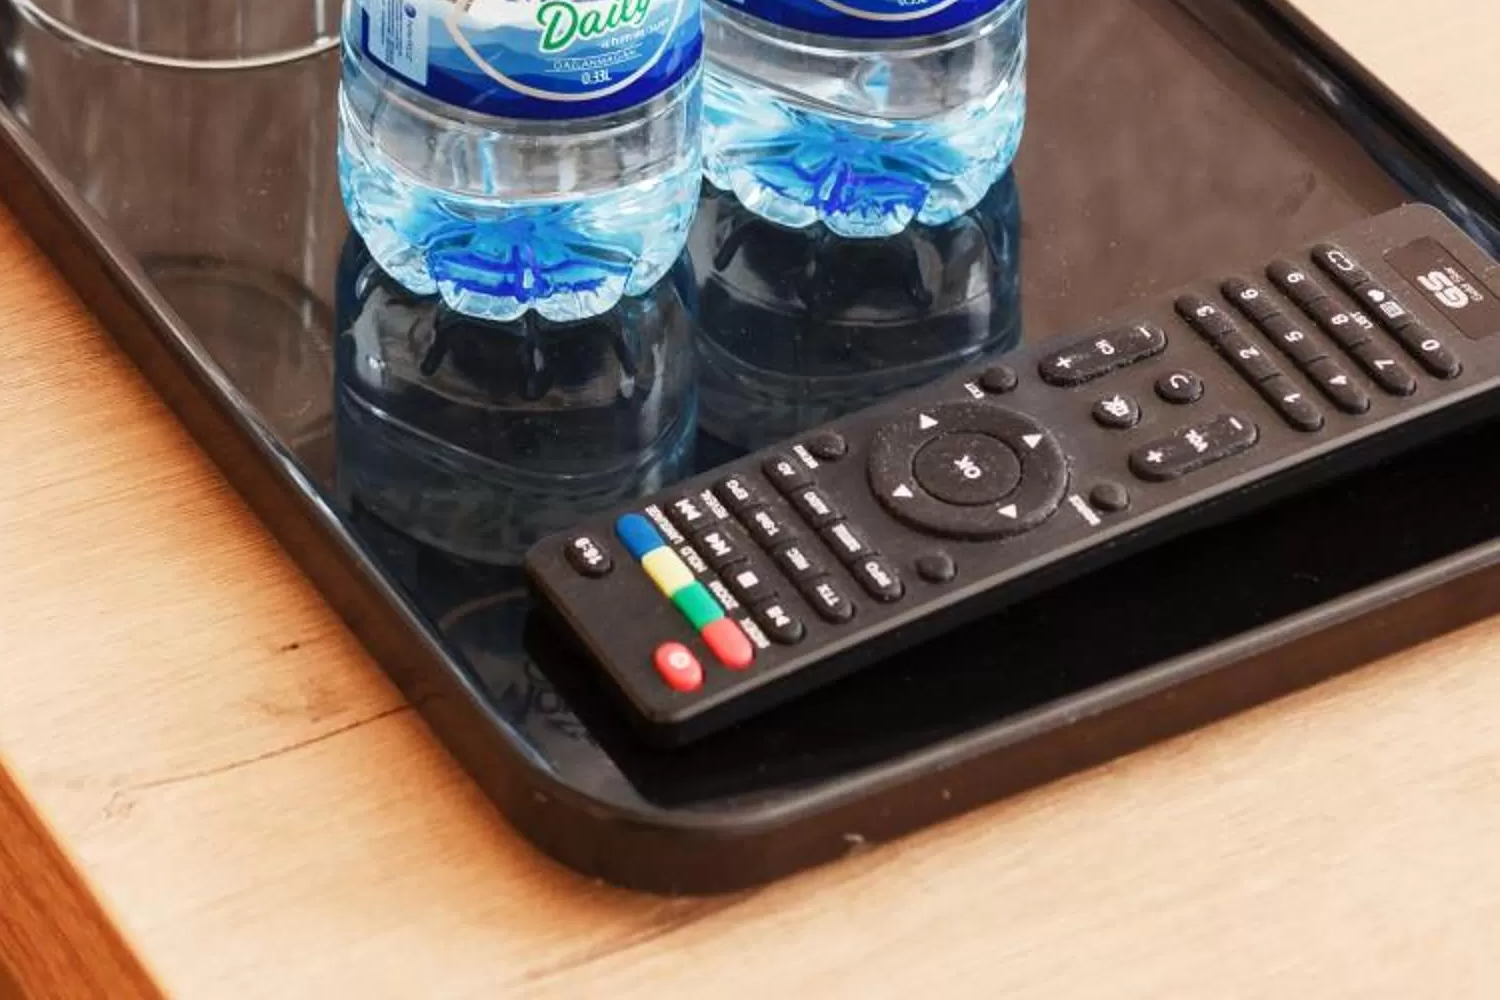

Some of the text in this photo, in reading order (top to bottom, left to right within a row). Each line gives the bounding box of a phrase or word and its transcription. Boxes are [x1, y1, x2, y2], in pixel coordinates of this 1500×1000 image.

[1196, 305, 1216, 317] 3
[1239, 346, 1260, 359] 2
[1374, 359, 1395, 370] 7
[954, 455, 982, 479] OK
